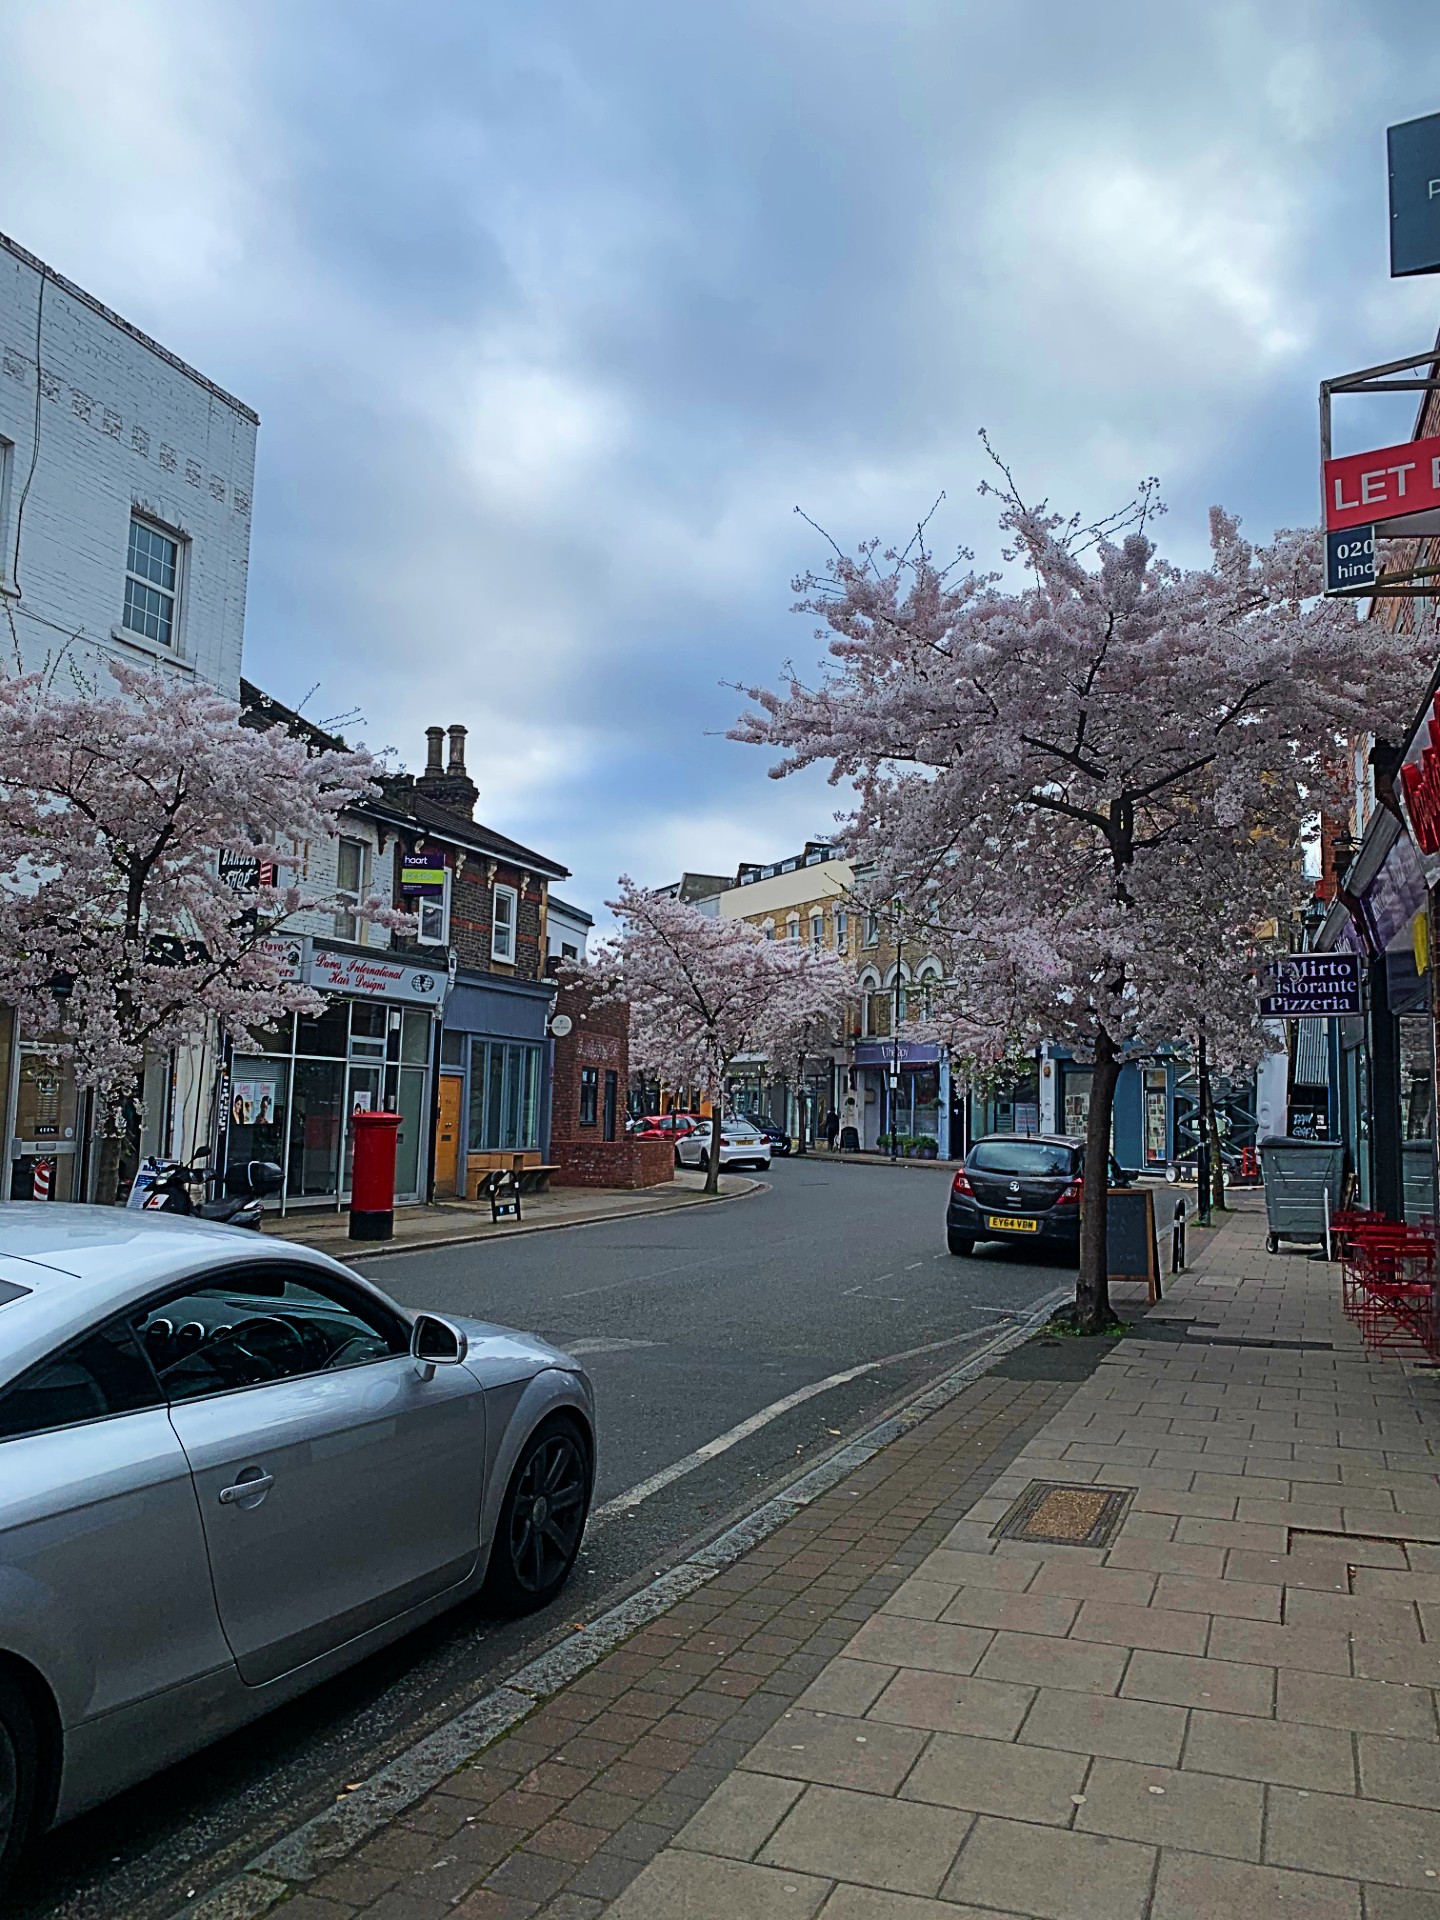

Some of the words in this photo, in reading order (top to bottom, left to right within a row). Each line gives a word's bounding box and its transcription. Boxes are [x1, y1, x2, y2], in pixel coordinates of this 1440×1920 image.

[1334, 462, 1416, 511] LET
[1336, 539, 1375, 560] 020
[404, 854, 428, 865] haart
[346, 959, 406, 981] International
[1288, 960, 1352, 978] Mirto
[327, 970, 350, 986] Hair
[354, 973, 387, 995] Designs
[1276, 978, 1358, 995] istorante
[1269, 995, 1351, 1012] Pizzeria
[992, 1217, 1015, 1228] EY64
